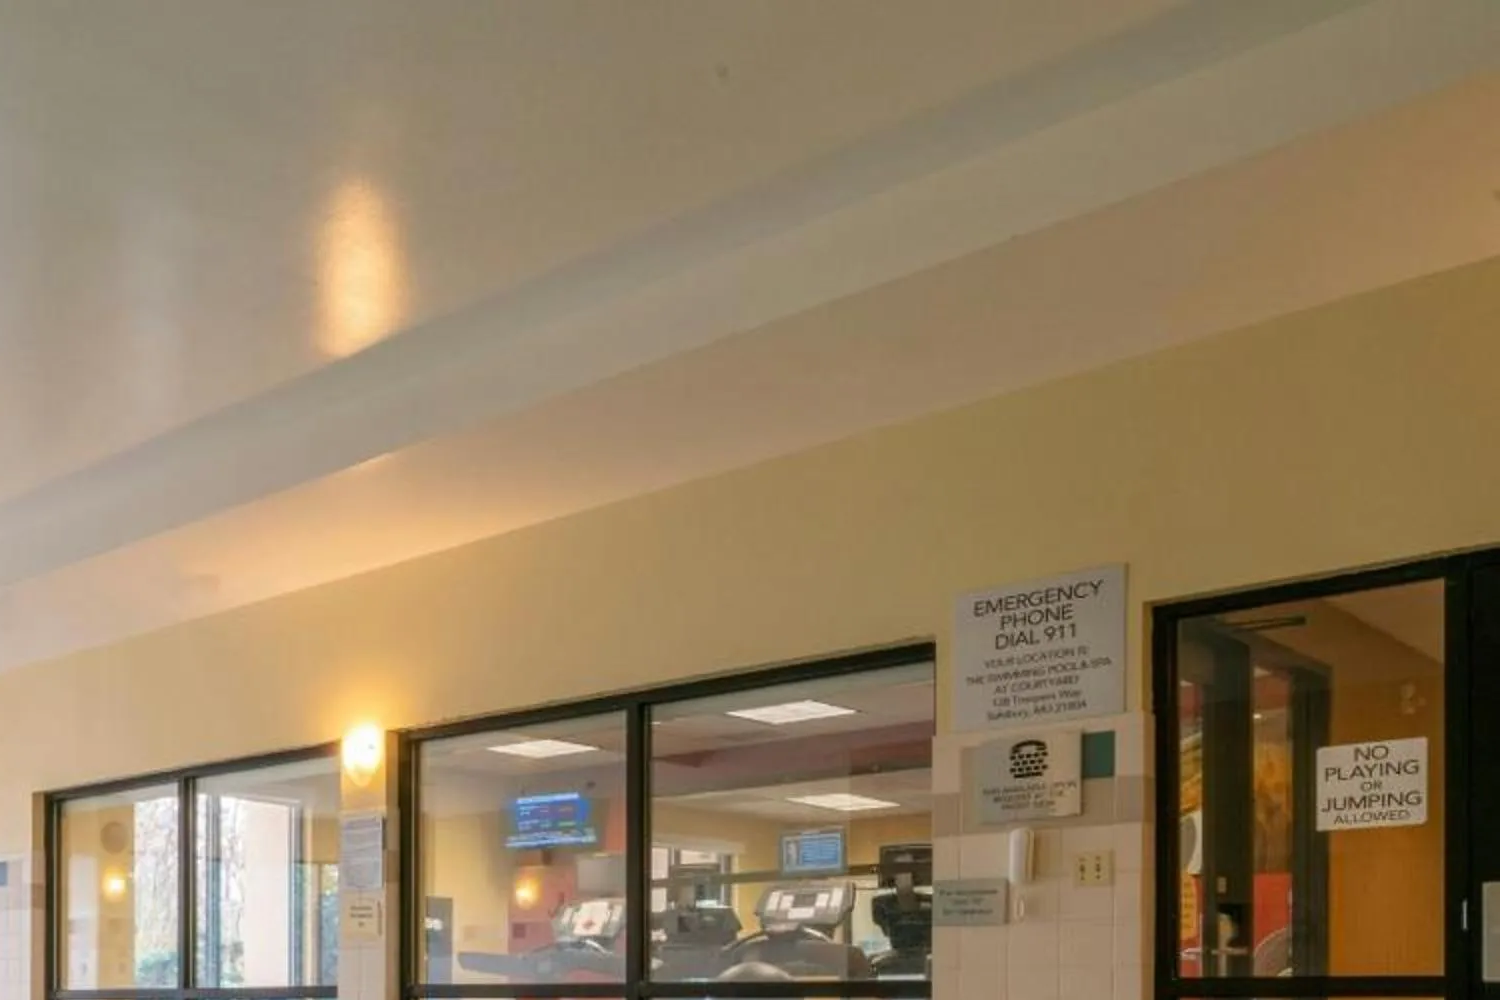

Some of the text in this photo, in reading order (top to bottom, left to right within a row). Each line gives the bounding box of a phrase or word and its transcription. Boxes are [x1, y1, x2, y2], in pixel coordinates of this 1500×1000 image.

[973, 579, 1105, 617] EMERGENCY
[1000, 603, 1074, 630] PHONE
[995, 623, 1077, 651] DIAL 911
[1017, 648, 1075, 665] LOCATION
[1048, 661, 1079, 675] POOL
[993, 675, 1080, 695] AT COURTYARD
[1353, 745, 1389, 762] NO
[1324, 759, 1420, 782] PLAYING
[1360, 780, 1383, 792] OR
[1321, 790, 1422, 813] JUMPING
[1333, 809, 1410, 825] ALLOWED
